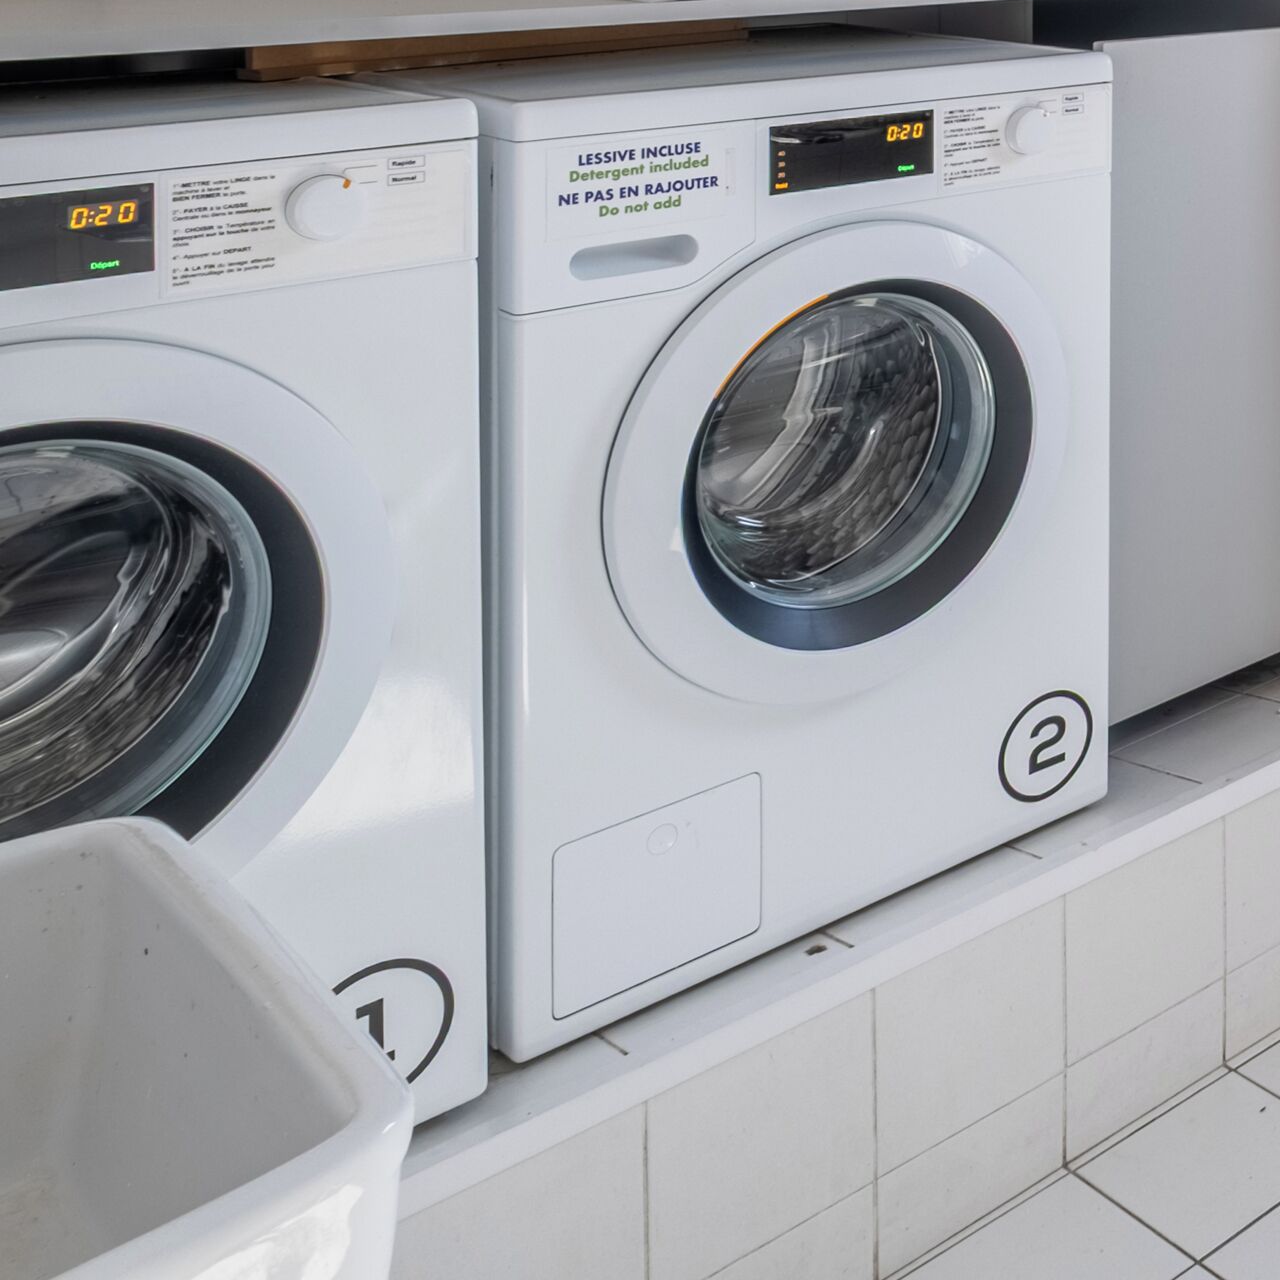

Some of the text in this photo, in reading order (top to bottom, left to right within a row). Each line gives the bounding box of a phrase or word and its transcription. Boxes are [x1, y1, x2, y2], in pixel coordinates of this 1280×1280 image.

[886, 123, 924, 142] 0:20
[578, 142, 701, 166] LESSIVE INCLUSE
[569, 155, 709, 183] Detergent included
[558, 176, 719, 206] NE PAS EN RAJOUTER
[70, 201, 136, 229] 0:20
[599, 195, 682, 217] Do not add
[90, 260, 120, 269] Départ
[1028, 715, 1067, 776] 2
[355, 997, 396, 1060] 1
